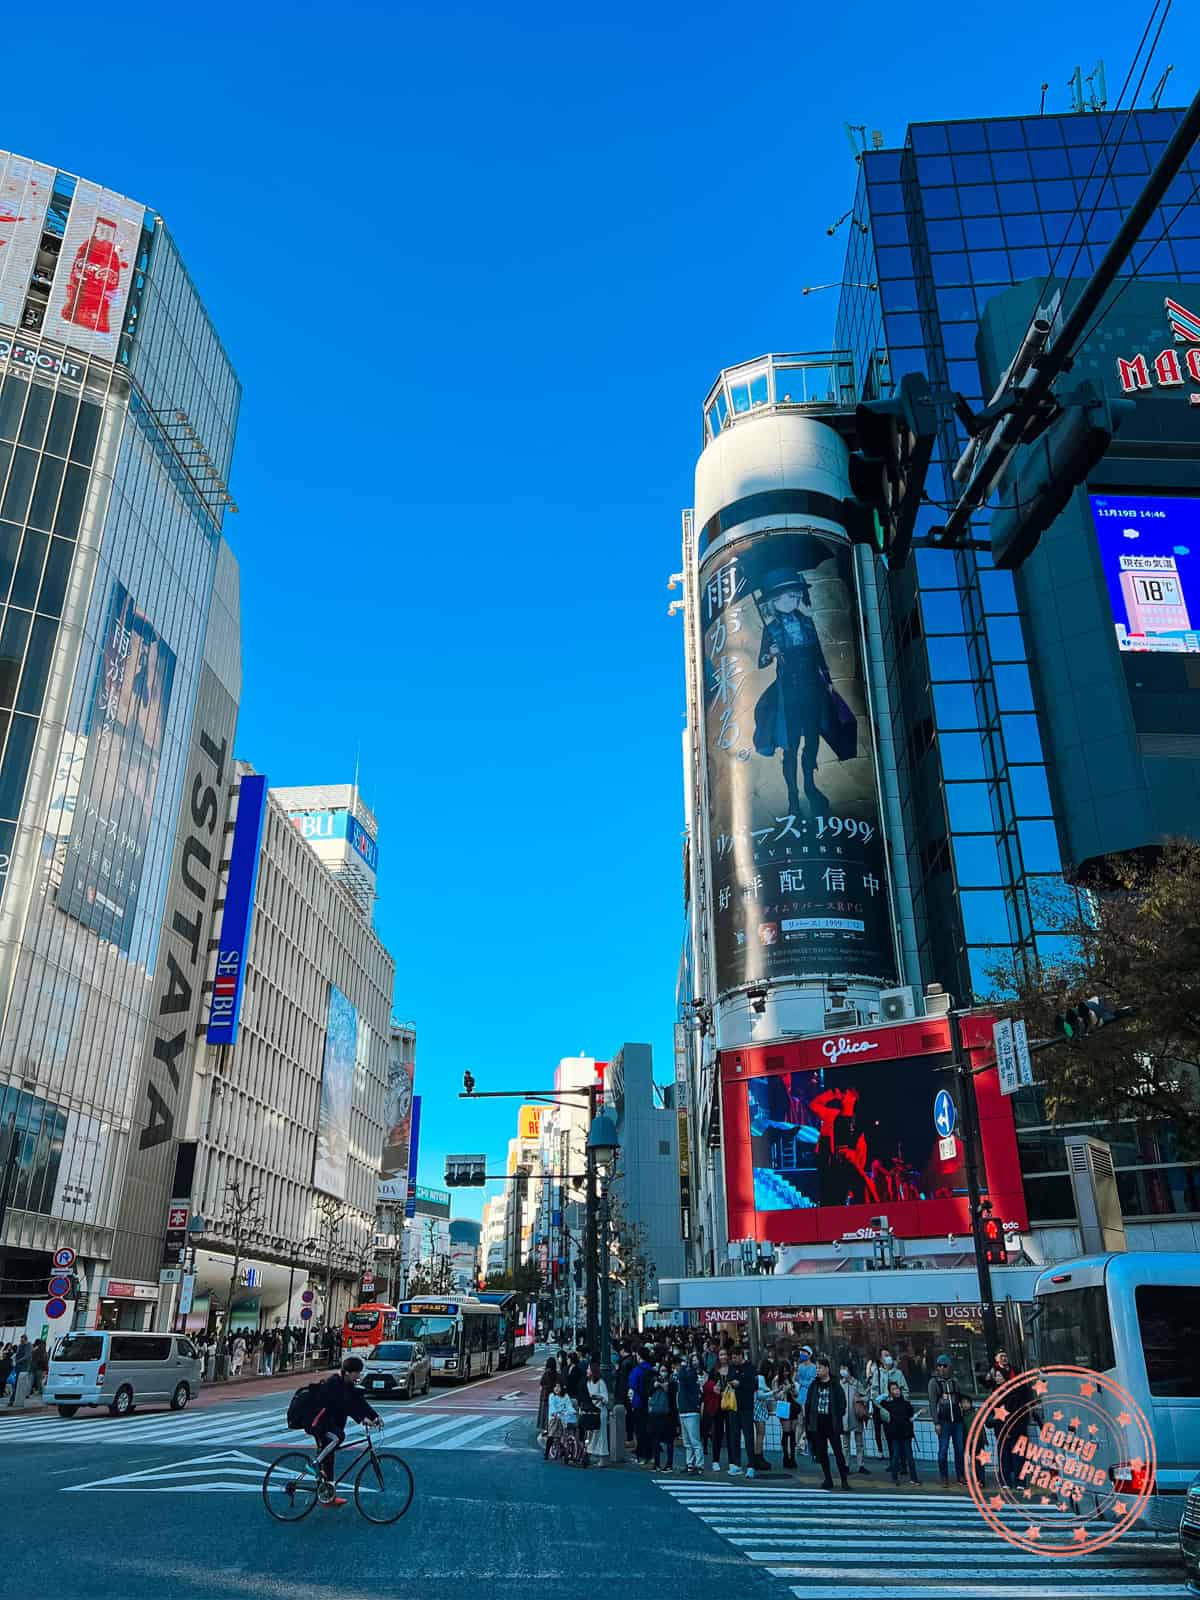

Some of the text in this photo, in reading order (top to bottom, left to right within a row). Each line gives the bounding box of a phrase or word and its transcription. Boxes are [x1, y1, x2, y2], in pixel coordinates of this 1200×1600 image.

[139, 727, 228, 1151] TSUTAYA
[210, 950, 239, 1029] SEIBU
[821, 1037, 879, 1064] Glico
